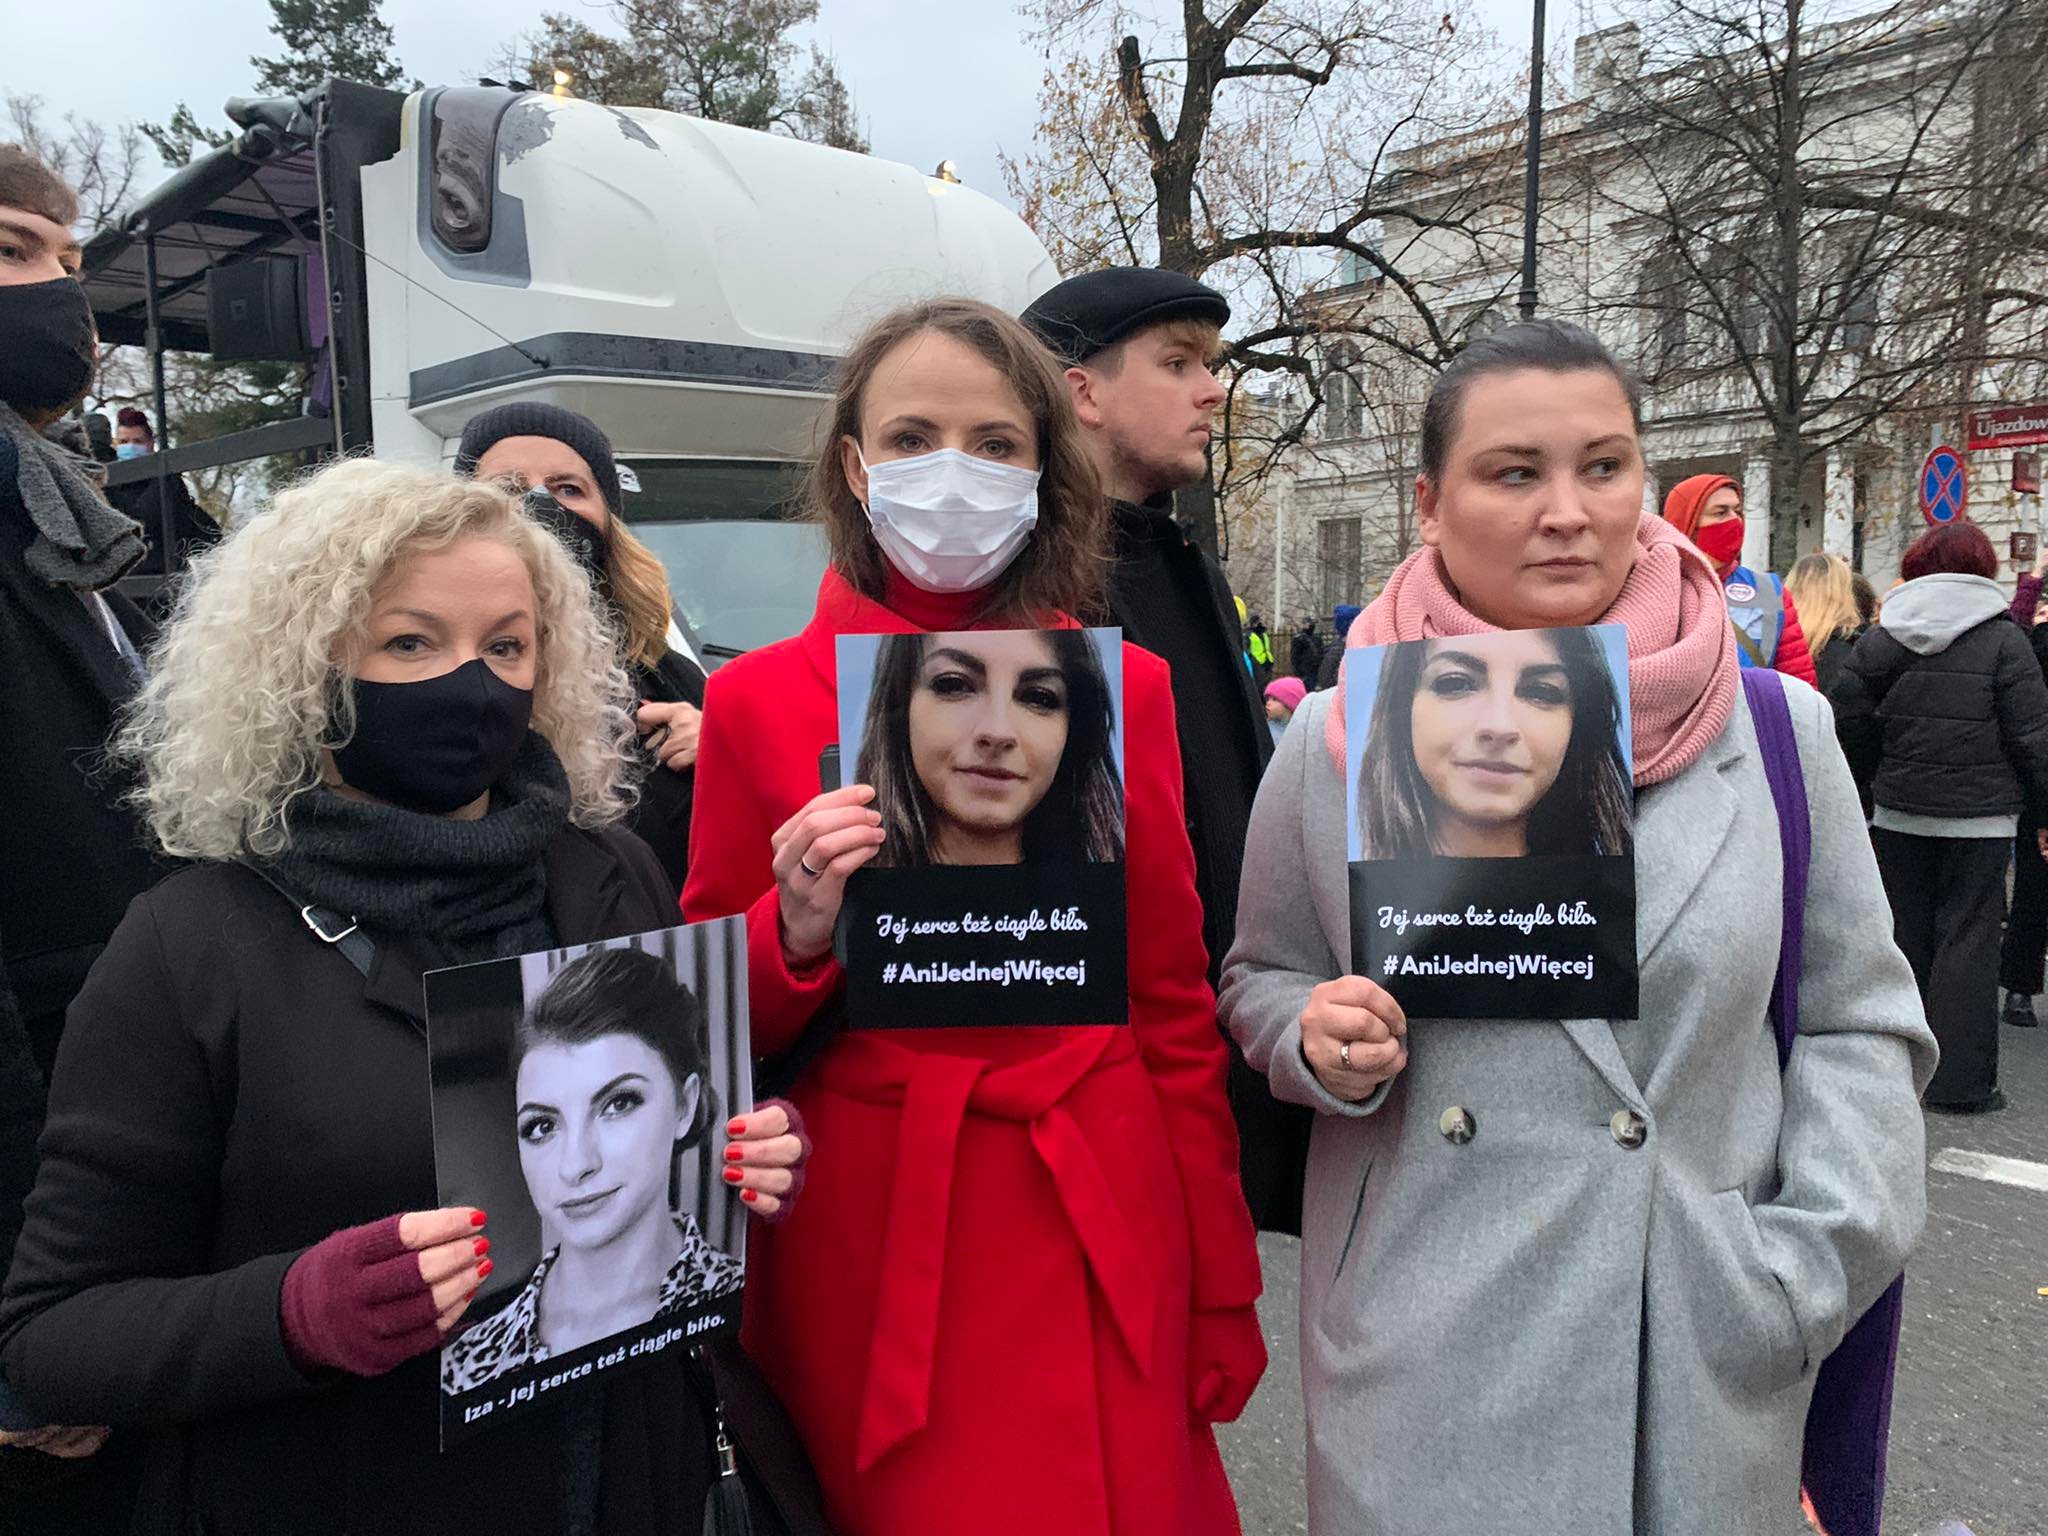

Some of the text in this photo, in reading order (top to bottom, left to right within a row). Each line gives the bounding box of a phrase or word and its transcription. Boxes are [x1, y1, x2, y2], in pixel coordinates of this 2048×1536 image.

[876, 906, 1088, 944] Jej serce też ciągle biło.
[1377, 900, 1597, 935] Jej serce też ciągle biło.
[882, 959, 1086, 987] #AniJednejWięcej
[1382, 953, 1594, 980] #AniJednejWięcej
[464, 1399, 493, 1424] Iza
[506, 1380, 535, 1408] Jej
[540, 1361, 592, 1391] serce
[597, 1346, 625, 1370] też
[630, 1328, 682, 1357] ciągle
[686, 1312, 726, 1336] biło.
